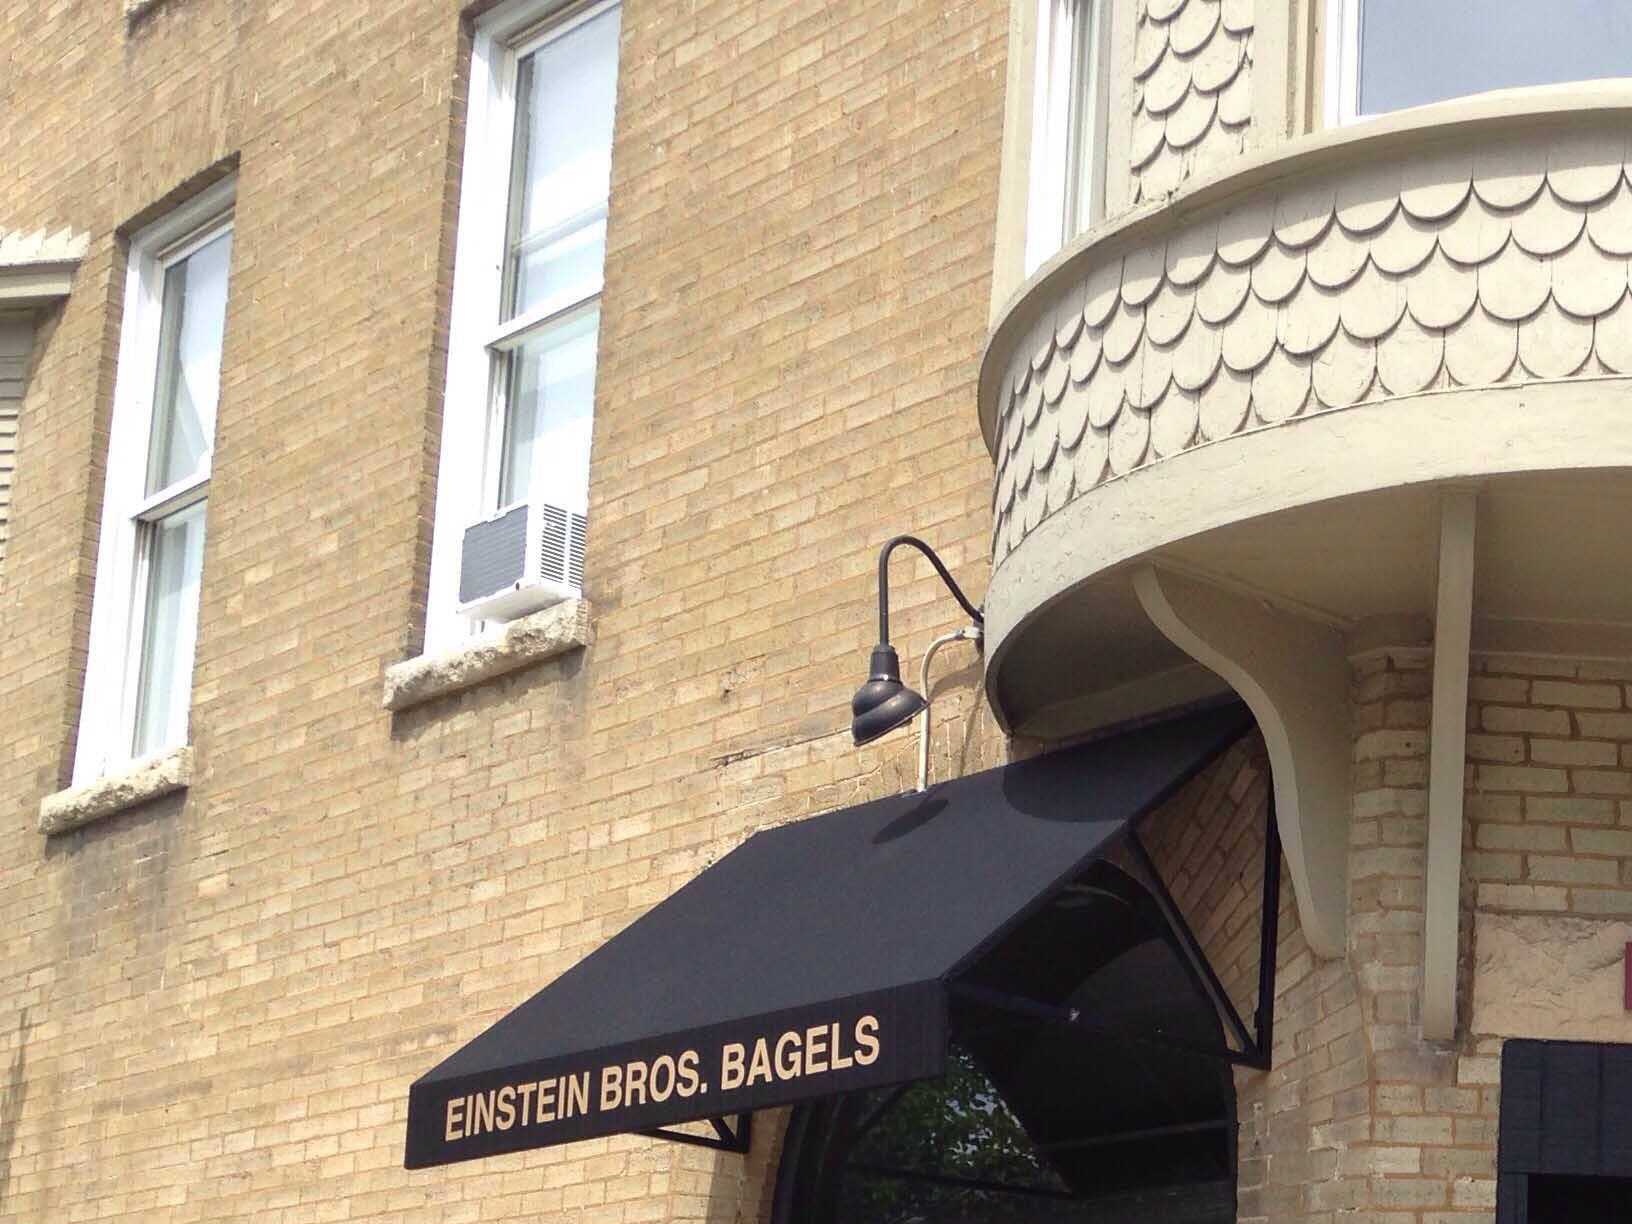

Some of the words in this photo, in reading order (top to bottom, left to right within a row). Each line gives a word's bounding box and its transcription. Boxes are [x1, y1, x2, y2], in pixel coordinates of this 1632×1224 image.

[445, 1071, 590, 1142] EINSTEIN
[599, 1050, 707, 1112] BROS.
[720, 1014, 881, 1091] BAGELS
